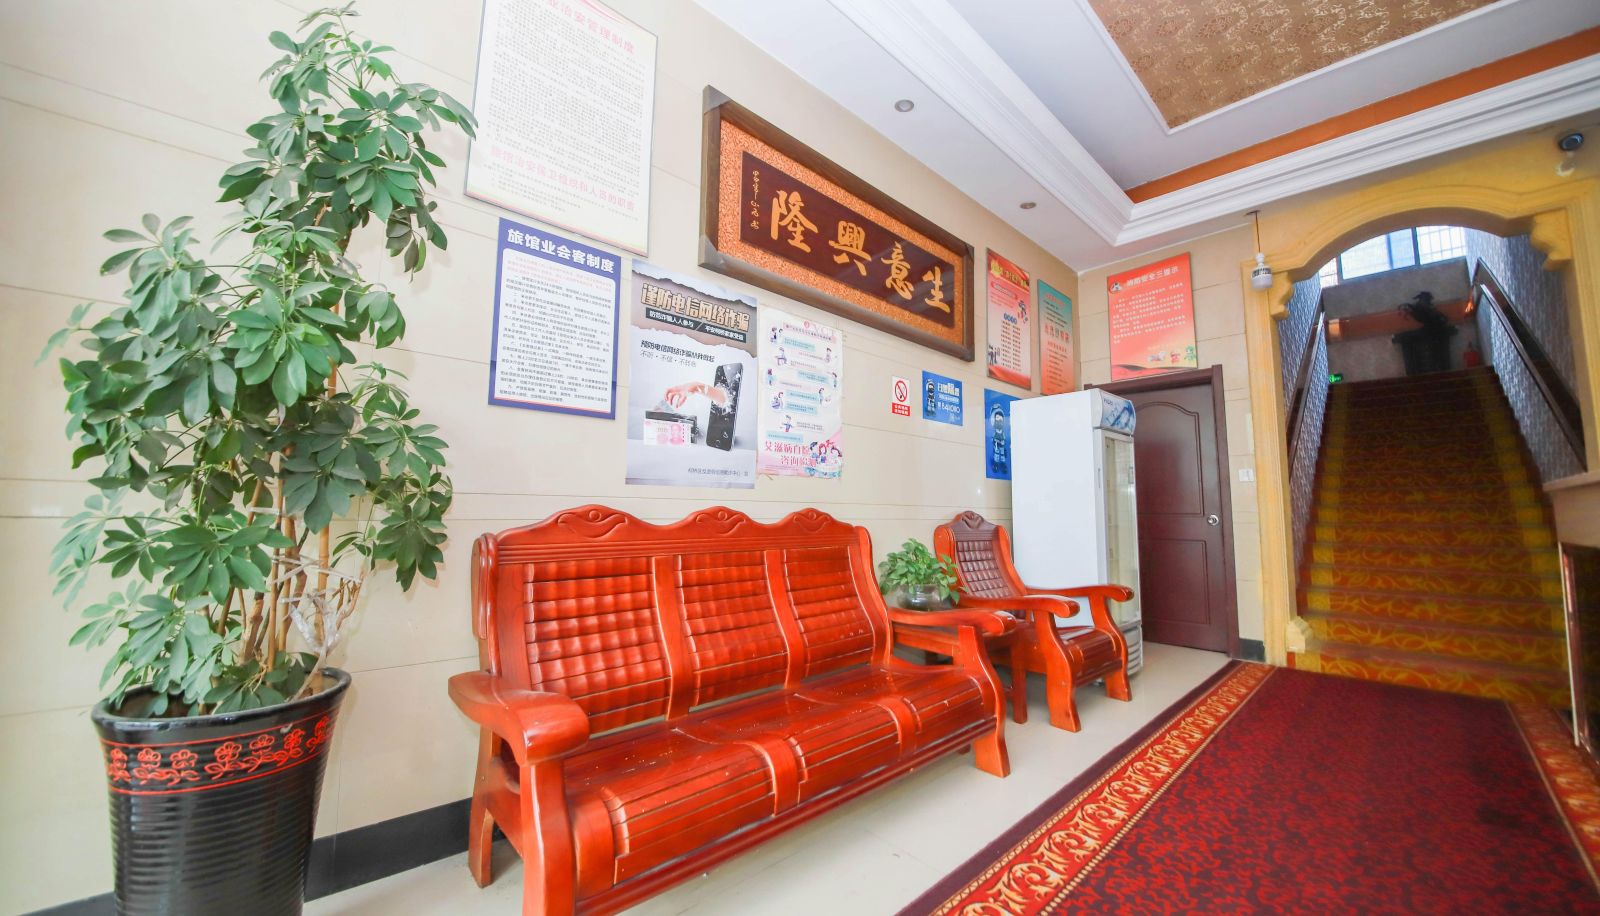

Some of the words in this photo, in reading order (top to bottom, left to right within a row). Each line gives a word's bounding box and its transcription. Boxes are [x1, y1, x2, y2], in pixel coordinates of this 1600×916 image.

[507, 228, 615, 274] 旅馆业会客制度
[641, 282, 751, 332] 谨防电信网络诈骗
